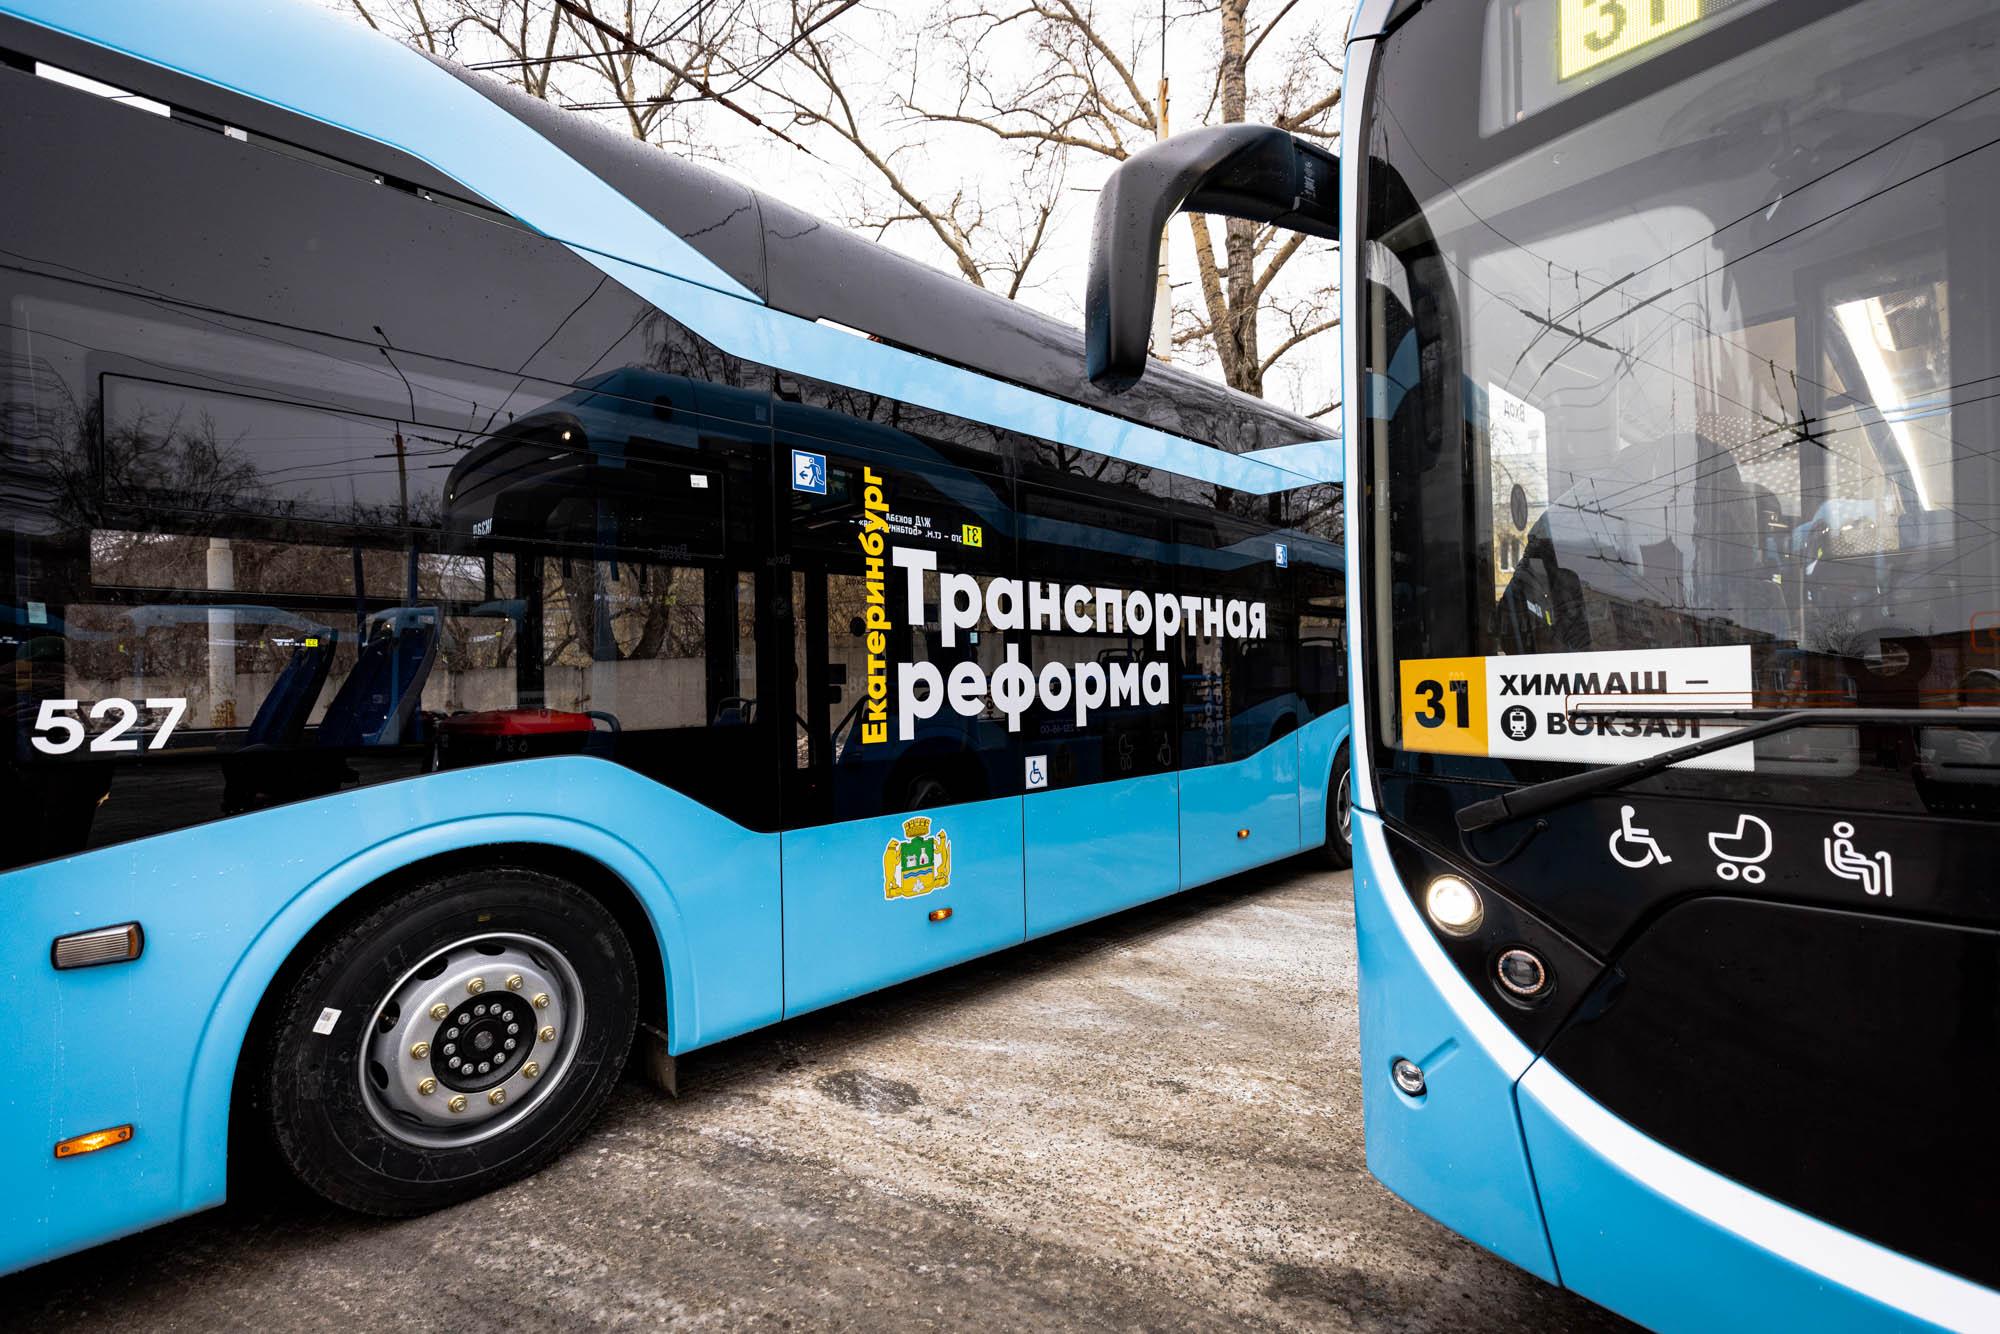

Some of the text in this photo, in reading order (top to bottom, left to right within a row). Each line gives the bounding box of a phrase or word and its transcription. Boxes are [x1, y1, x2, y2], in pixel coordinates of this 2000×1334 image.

[859, 467, 891, 744] Екатеринбург
[893, 547, 1267, 650] Транспортная
[898, 644, 1170, 740] реформа
[1415, 680, 1470, 729] 31
[1499, 671, 1667, 696] ХИММАШ
[31, 698, 187, 755] 527
[1547, 711, 1701, 739] ВОКЗАЛ
